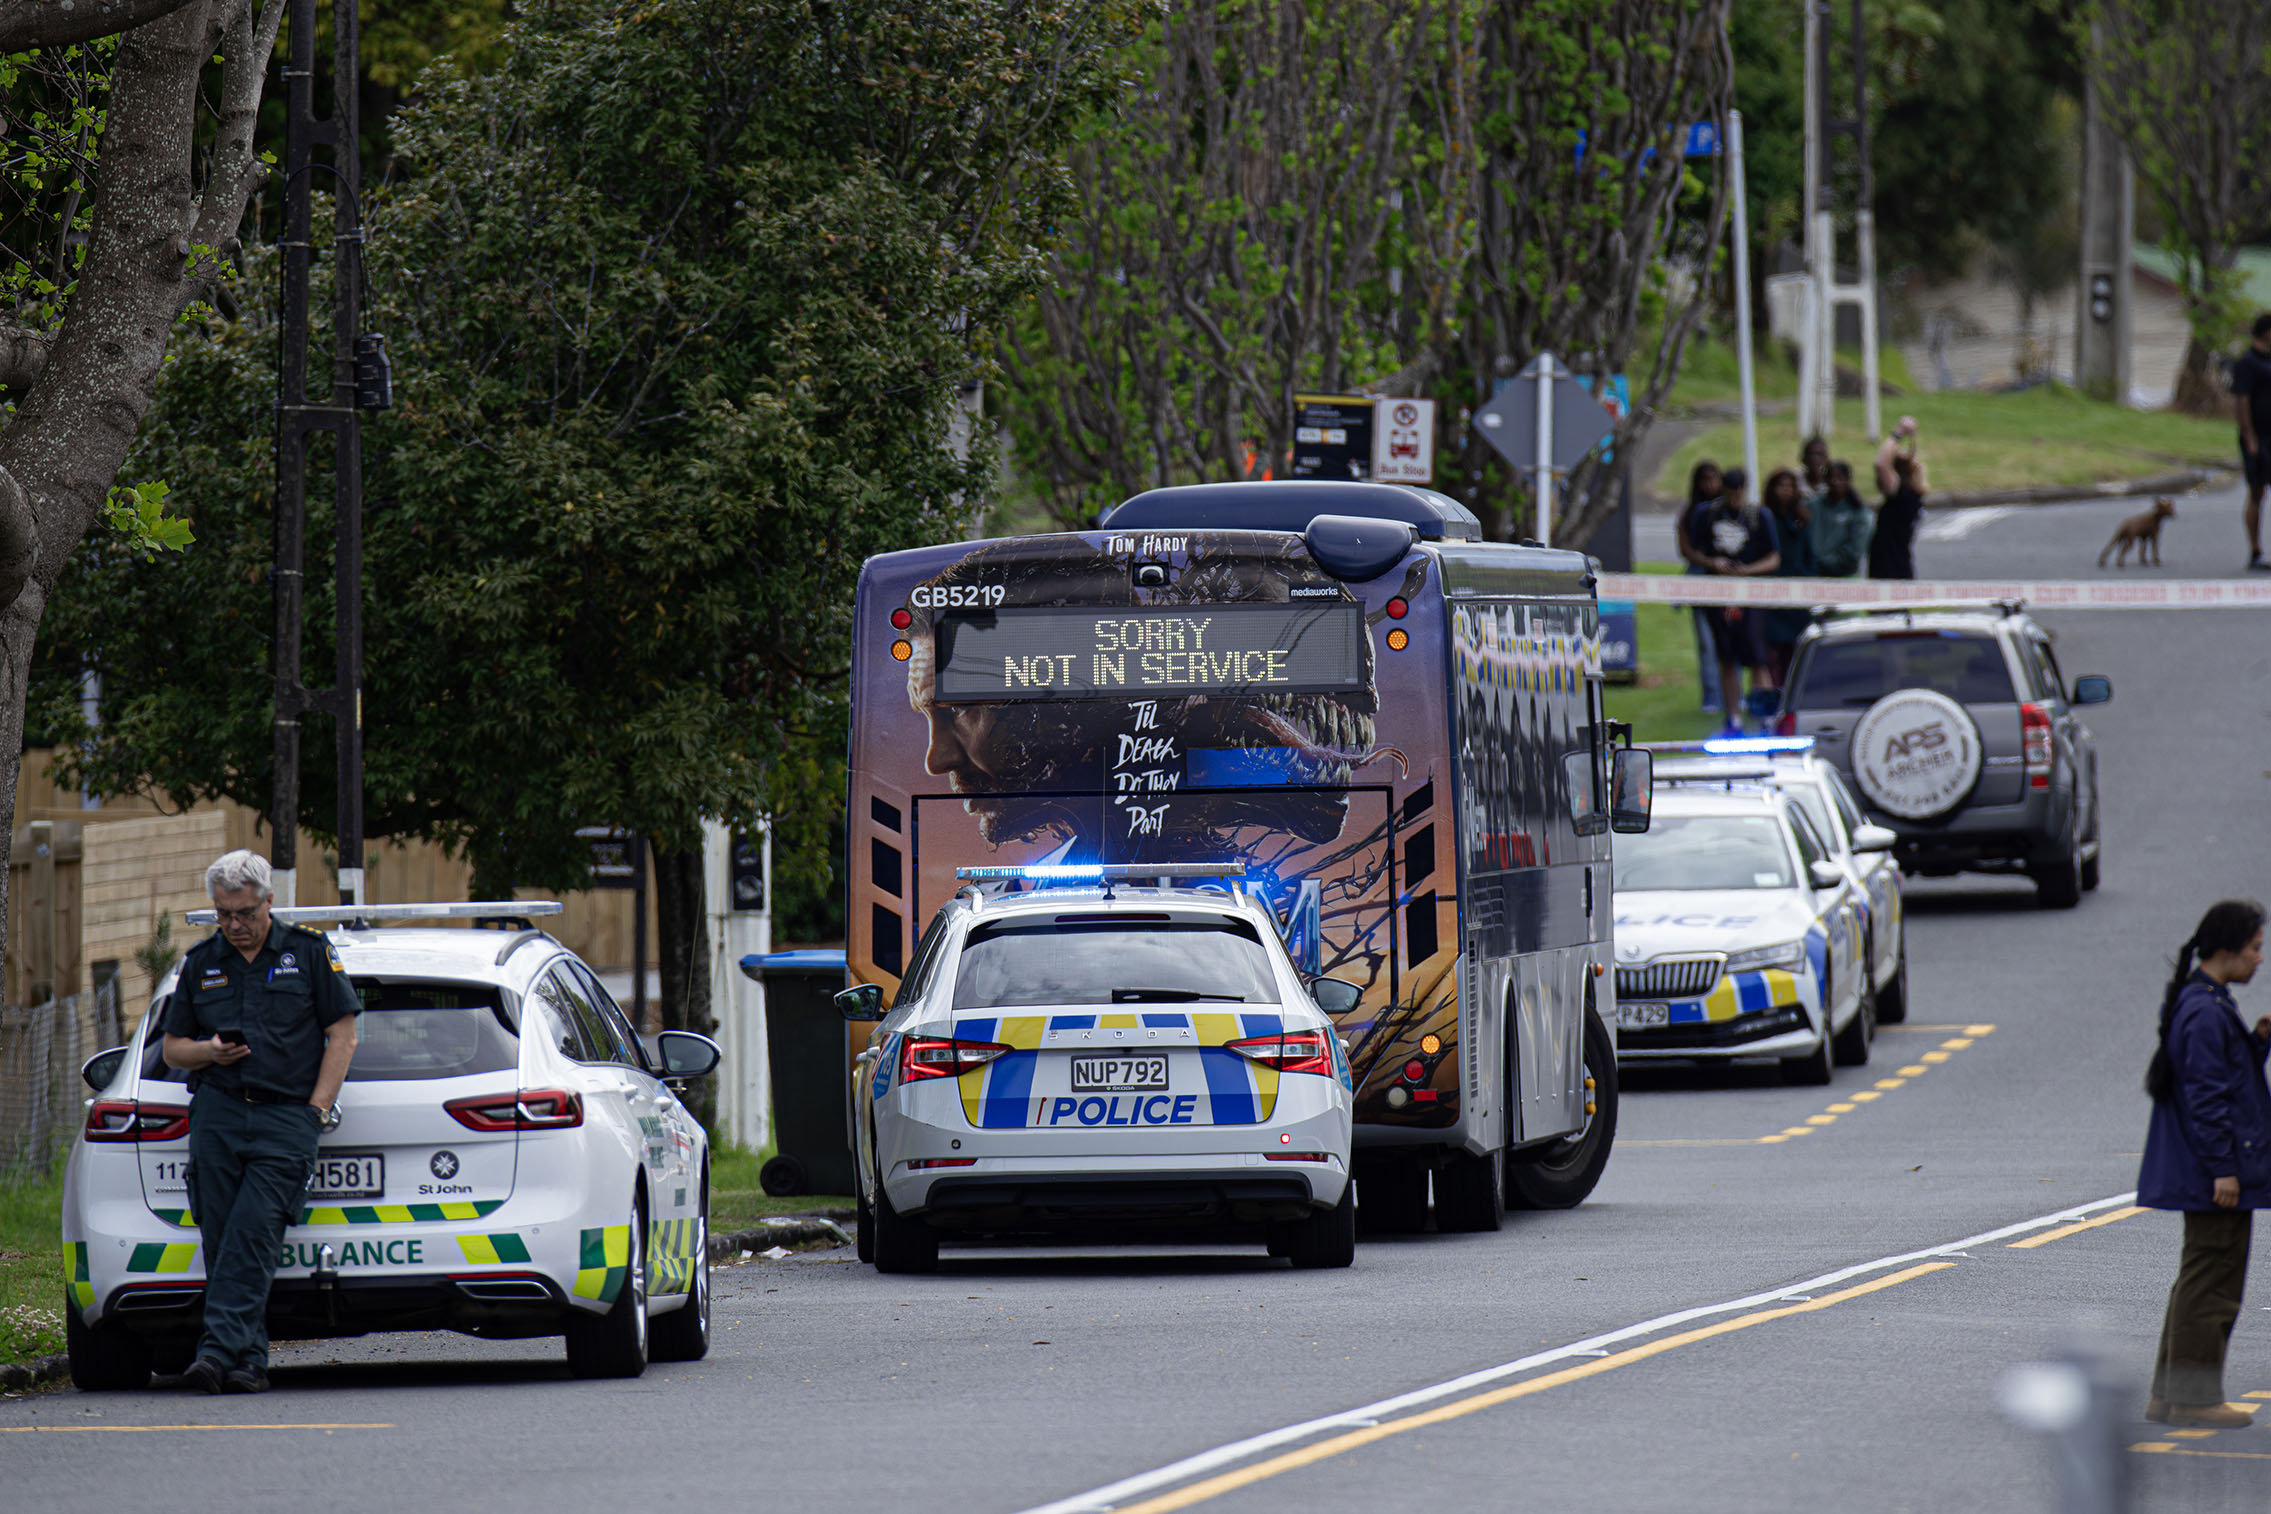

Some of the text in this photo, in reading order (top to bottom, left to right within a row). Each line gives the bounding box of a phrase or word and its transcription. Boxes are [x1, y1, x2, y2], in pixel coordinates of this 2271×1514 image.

[1108, 535, 1189, 556] TOM HARDY
[911, 585, 1006, 608] GB5219
[1290, 587, 1339, 597] mediaworks
[1095, 617, 1212, 651] SORRY
[1004, 649, 1289, 687] NOT IN SERVICE
[1614, 913, 1758, 929] LICE
[1615, 1006, 1666, 1025] P429
[1075, 1061, 1164, 1084] NUP792
[1050, 1095, 1198, 1126] POLICE
[311, 1161, 375, 1188] H581
[418, 1184, 472, 1195] St John
[279, 1240, 423, 1268] BUANCE
